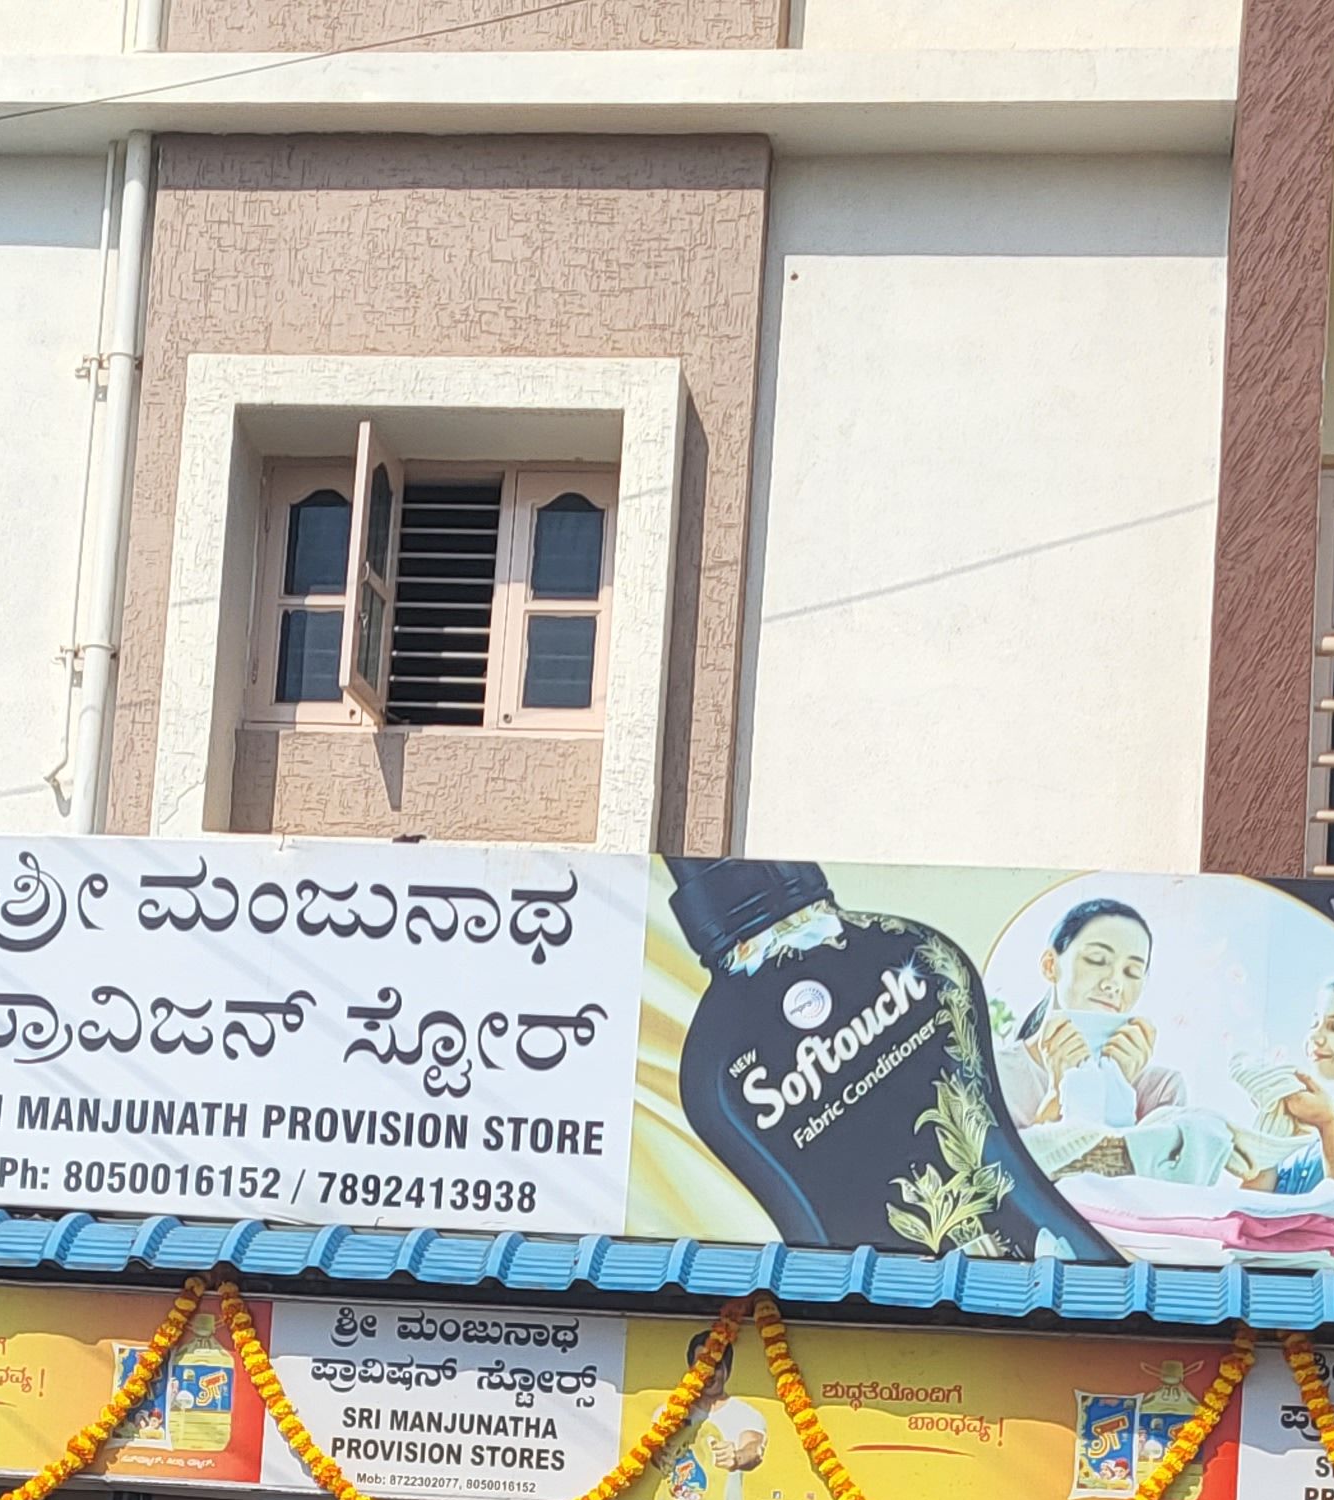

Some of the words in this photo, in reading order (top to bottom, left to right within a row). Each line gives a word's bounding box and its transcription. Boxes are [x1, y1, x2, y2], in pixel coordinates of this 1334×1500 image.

[137, 855, 579, 965] ಮಂಜುನಾಥ
[343, 987, 609, 1098] ಸ್ಟೋರ್
[728, 1049, 757, 1078] NEW
[742, 969, 927, 1129] Softouch
[792, 1100, 844, 1149] Fabric
[842, 1018, 937, 1105] Conditioner
[16, 1095, 248, 1138] MANJUNATH
[262, 1104, 469, 1150] PROVISION
[482, 1115, 604, 1156] STORE
[63, 1160, 280, 1200] 8050016152
[317, 1171, 537, 1213] 7892413938
[331, 1306, 377, 1347] ಶ್ರೀ
[397, 1309, 580, 1353] ಮಂಜುನಾಥ
[310, 1355, 457, 1392] ಪ್ರಾವಿಷನ್
[342, 1406, 381, 1429] SRI
[389, 1408, 558, 1440] MANJUNATHA
[331, 1437, 462, 1465] PROVISION
[470, 1446, 565, 1471] STORES
[356, 1472, 386, 1486] Mob:
[389, 1474, 463, 1491] 8722302077,
[466, 1479, 537, 1494] 8050016152
